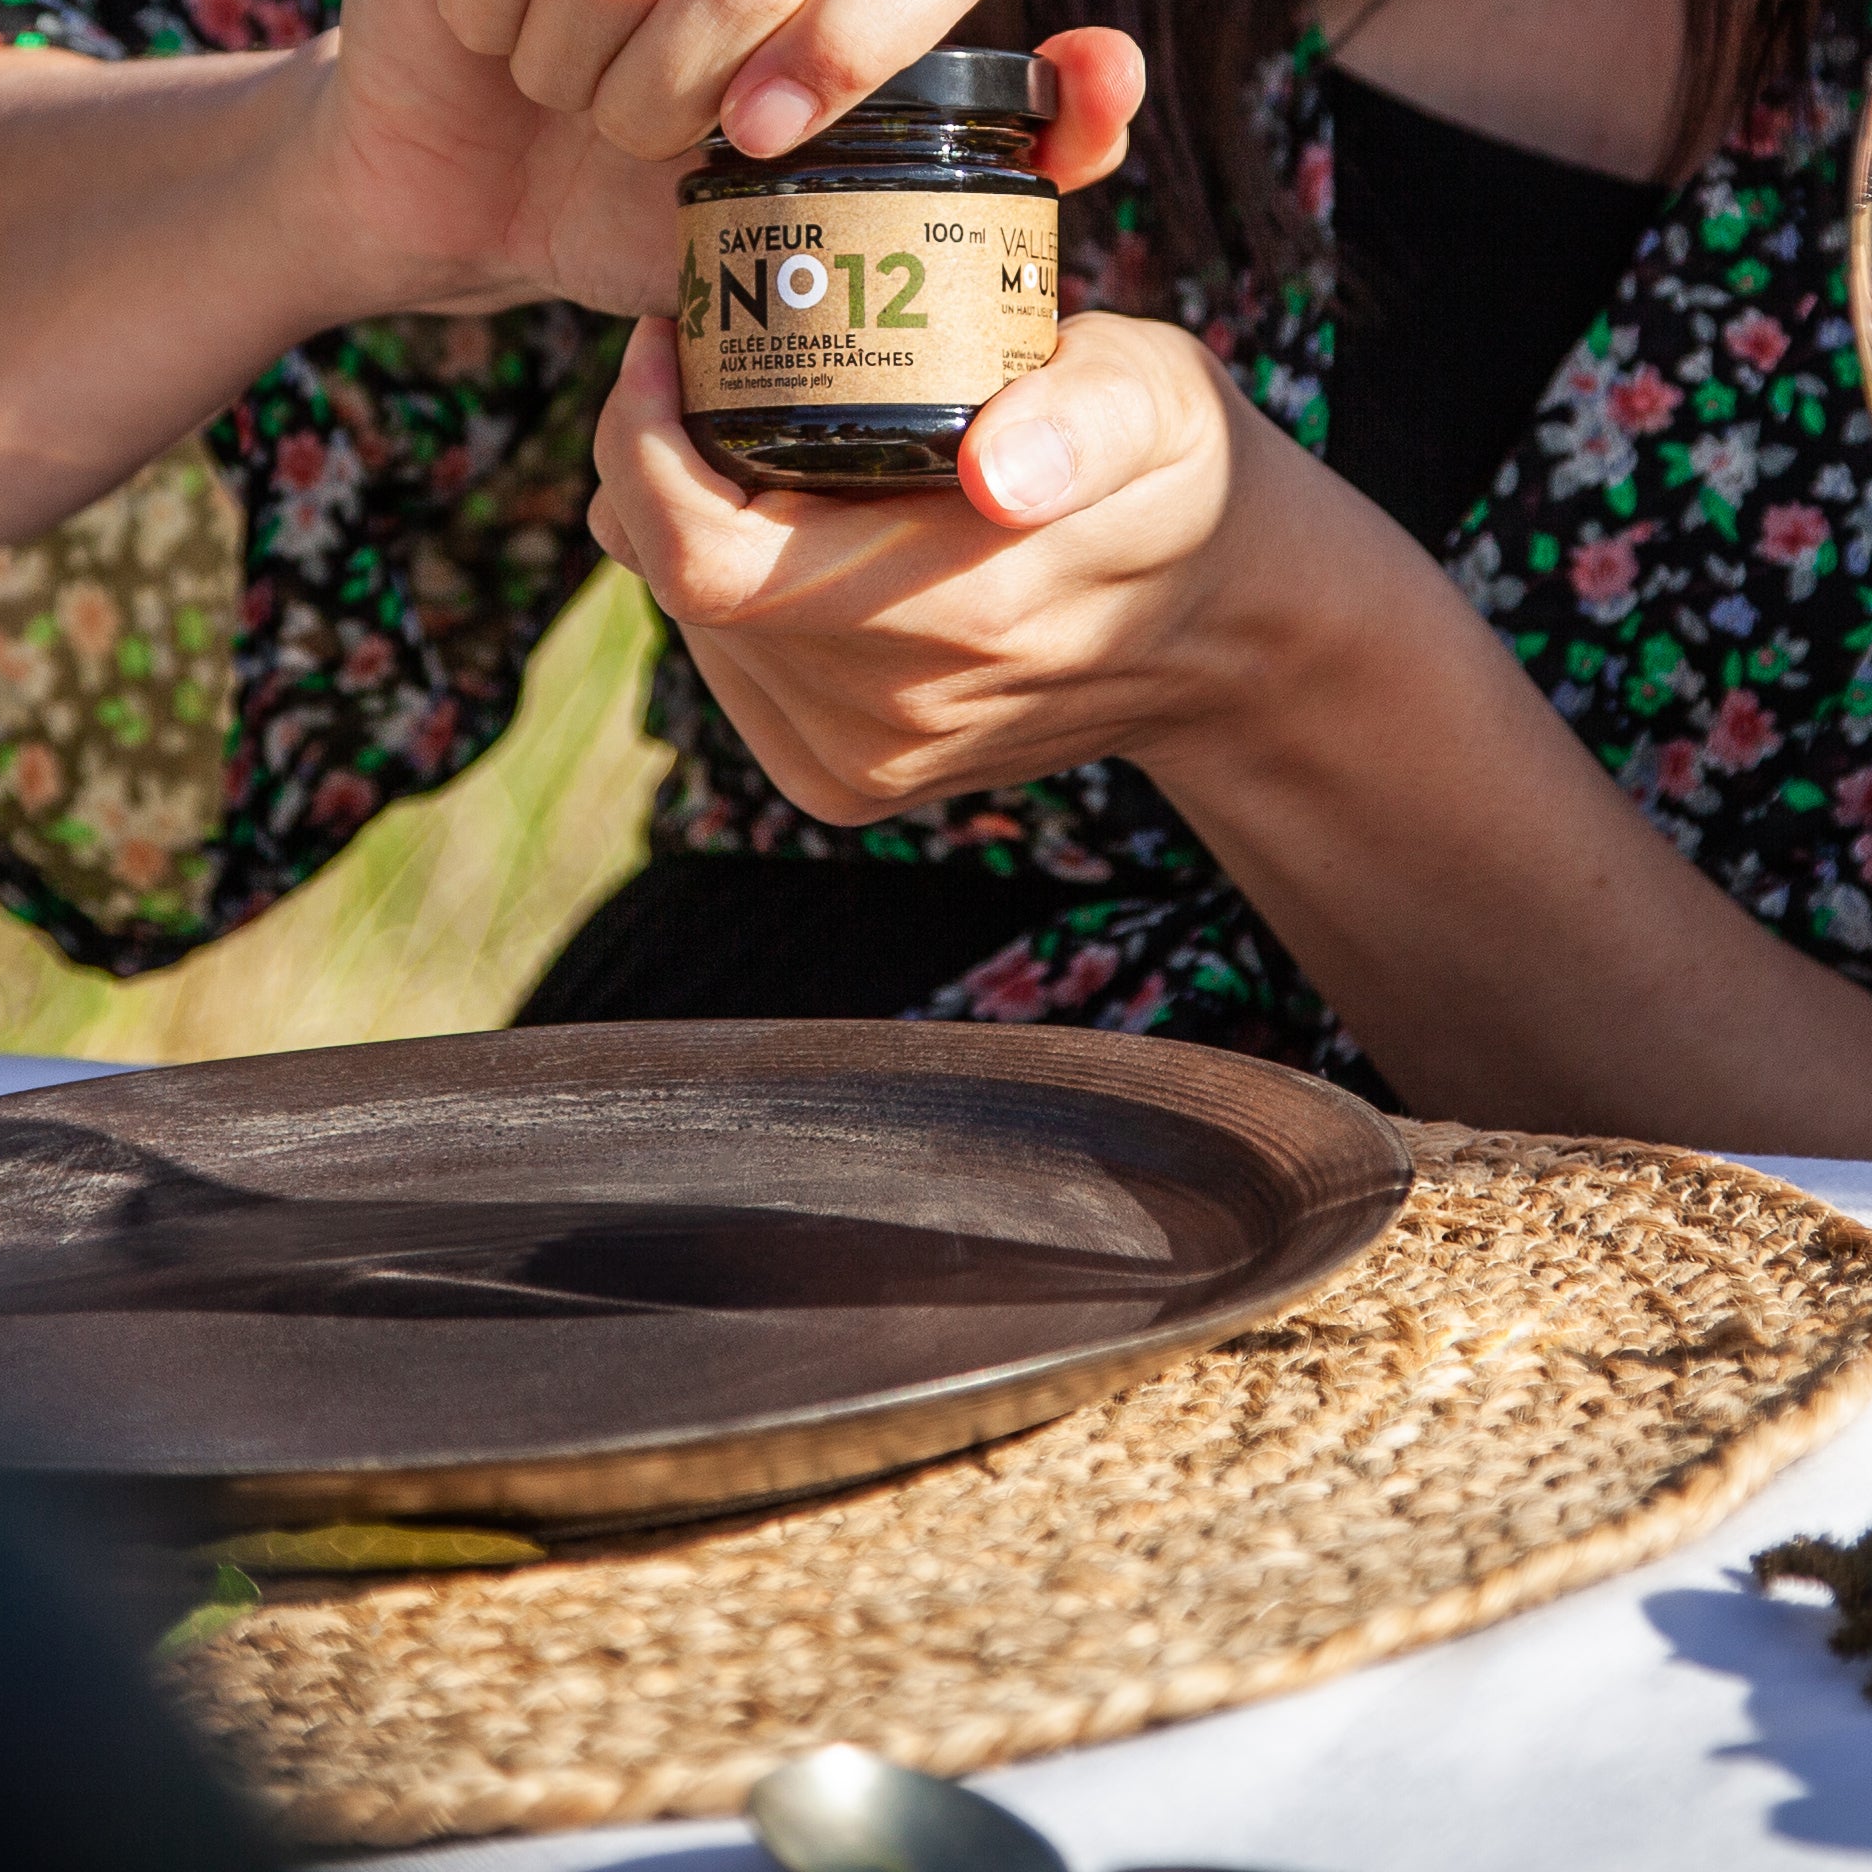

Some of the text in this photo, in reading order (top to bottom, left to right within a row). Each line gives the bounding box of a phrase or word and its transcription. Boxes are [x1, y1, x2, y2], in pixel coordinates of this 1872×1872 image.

[719, 223, 824, 255] SAVEUR
[924, 222, 986, 244] 100 ml
[720, 331, 857, 354] GELÉE D'ÉRABLE
[720, 348, 915, 372] AUX HERBES FRAÎCHES
[720, 373, 834, 391] Fresh herbs maple jelly
